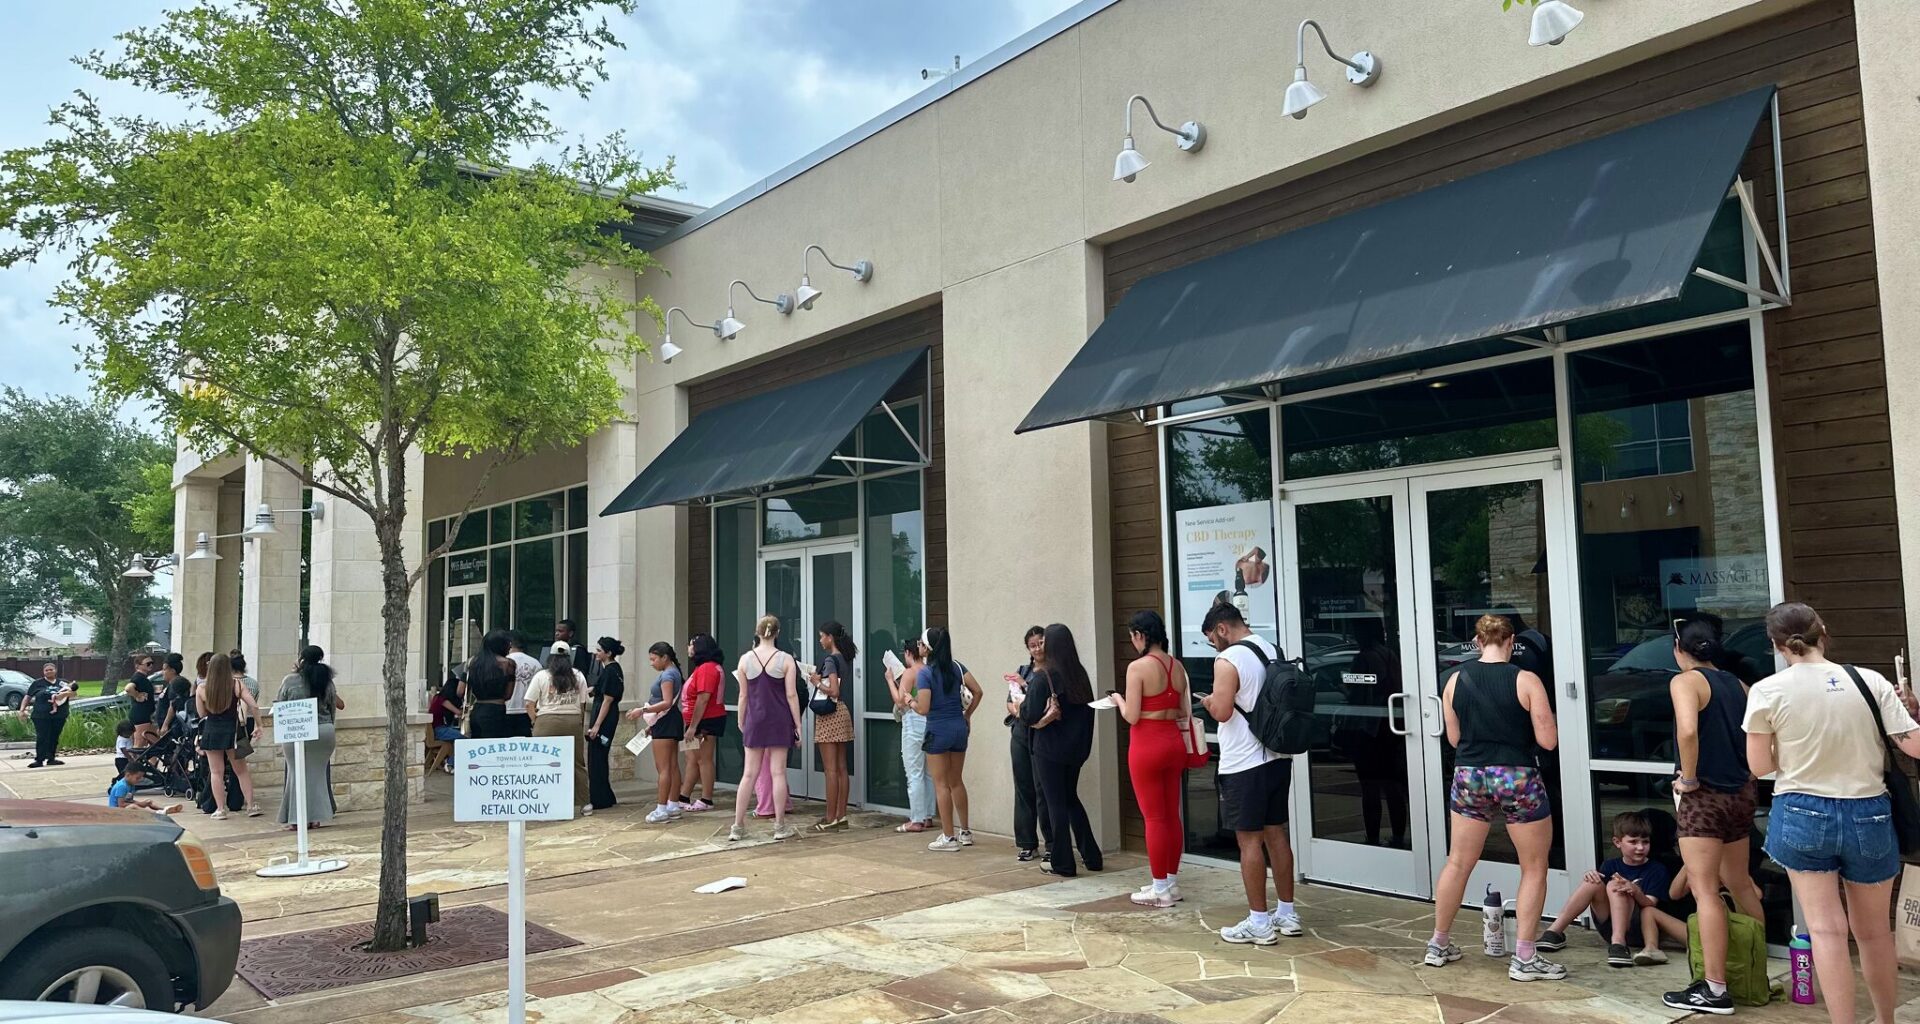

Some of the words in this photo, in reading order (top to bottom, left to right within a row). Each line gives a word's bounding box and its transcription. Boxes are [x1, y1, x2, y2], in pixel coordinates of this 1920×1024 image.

[1186, 531, 1209, 543] CBD
[1214, 529, 1256, 541] Therapy
[1690, 569, 1751, 585] MASSAGE
[278, 701, 312, 712] BOARDWALK
[287, 717, 313, 725] RESTAURANT
[468, 742, 562, 759] BOARDWALK
[470, 775, 488, 786] NO
[492, 773, 562, 786] RESTAURANT
[492, 788, 539, 800] PARKING
[481, 804, 515, 815] RETAIL
[518, 803, 550, 815] ONLY
